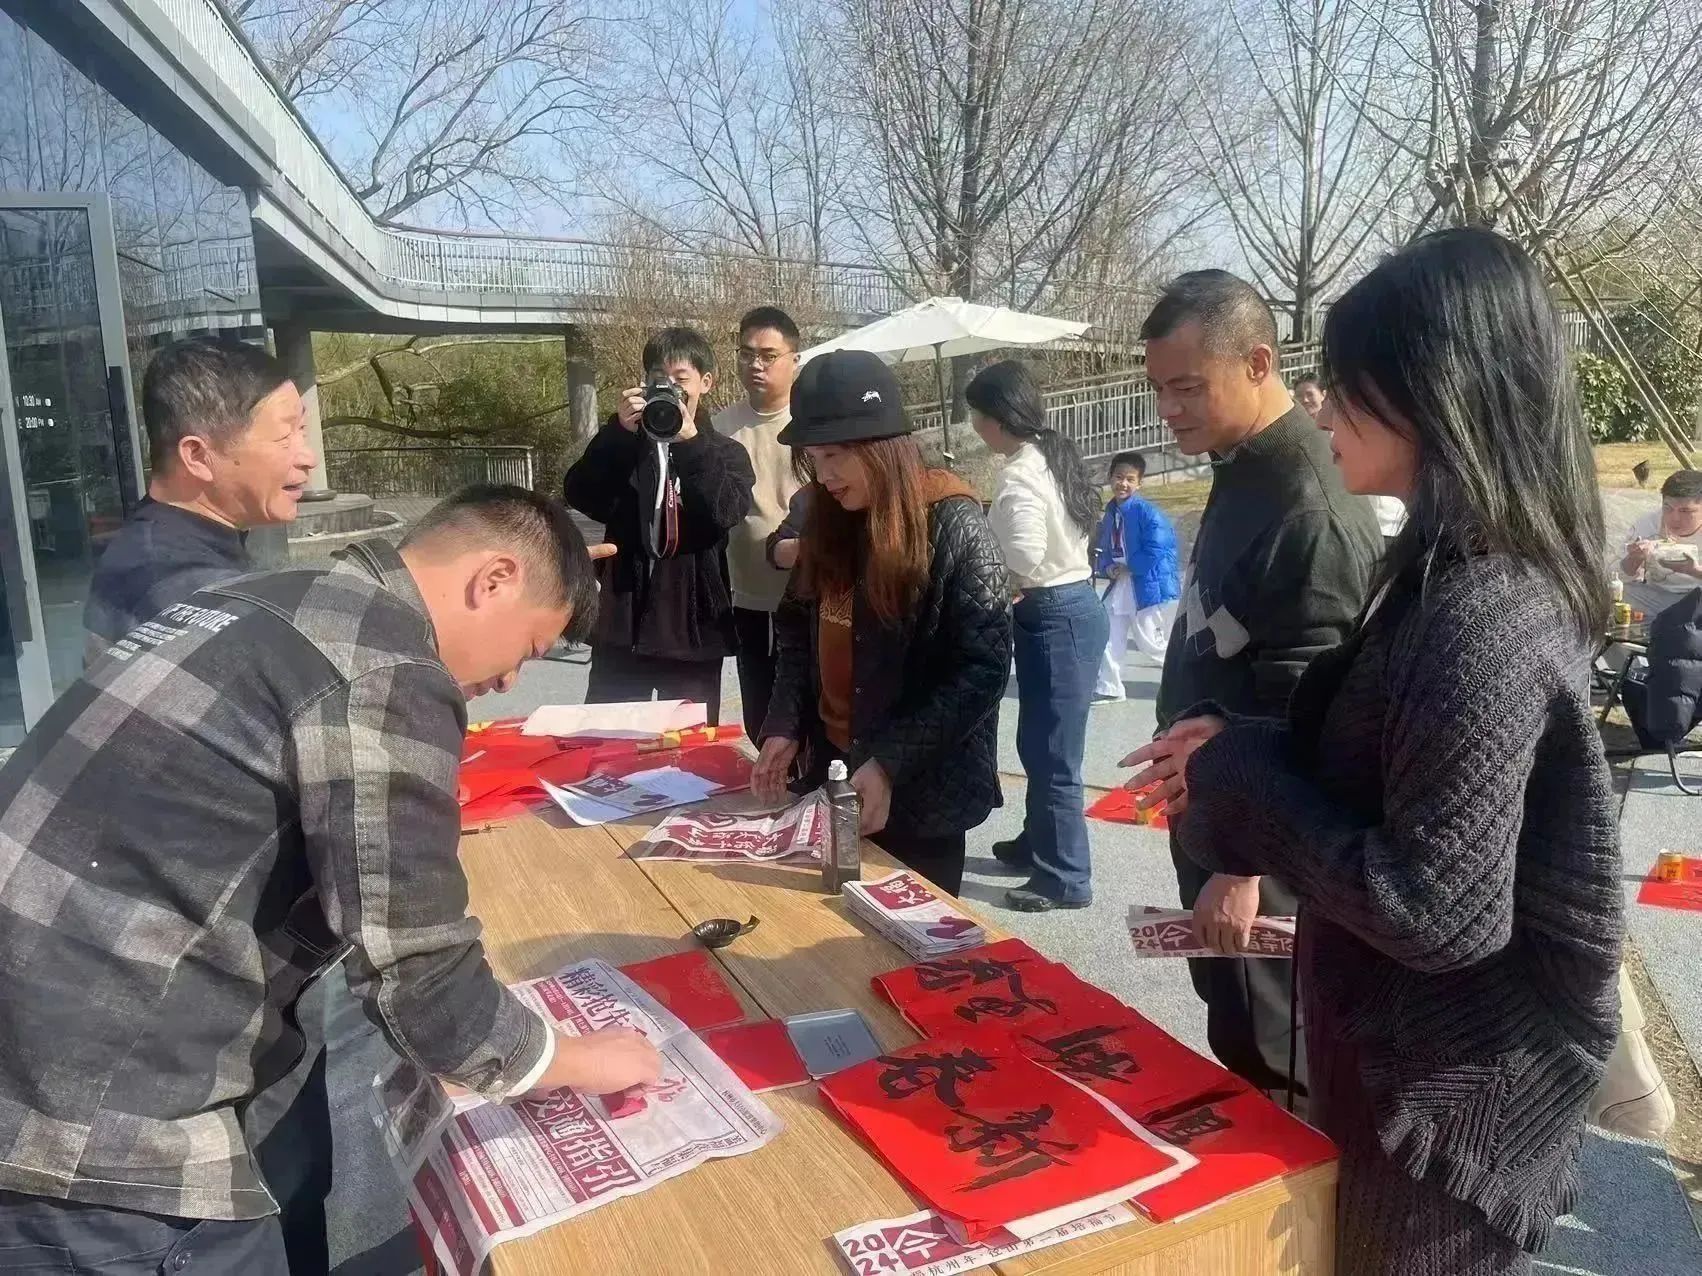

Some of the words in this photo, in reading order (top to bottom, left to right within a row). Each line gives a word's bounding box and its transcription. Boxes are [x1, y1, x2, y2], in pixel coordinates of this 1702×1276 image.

[1129, 926, 1155, 938] 20
[1135, 938, 1159, 950] 24
[558, 966, 647, 1038] 精彩抢先
[528, 1090, 637, 1194] 交通指引
[843, 1233, 884, 1257] 20
[855, 1253, 900, 1276] 24
